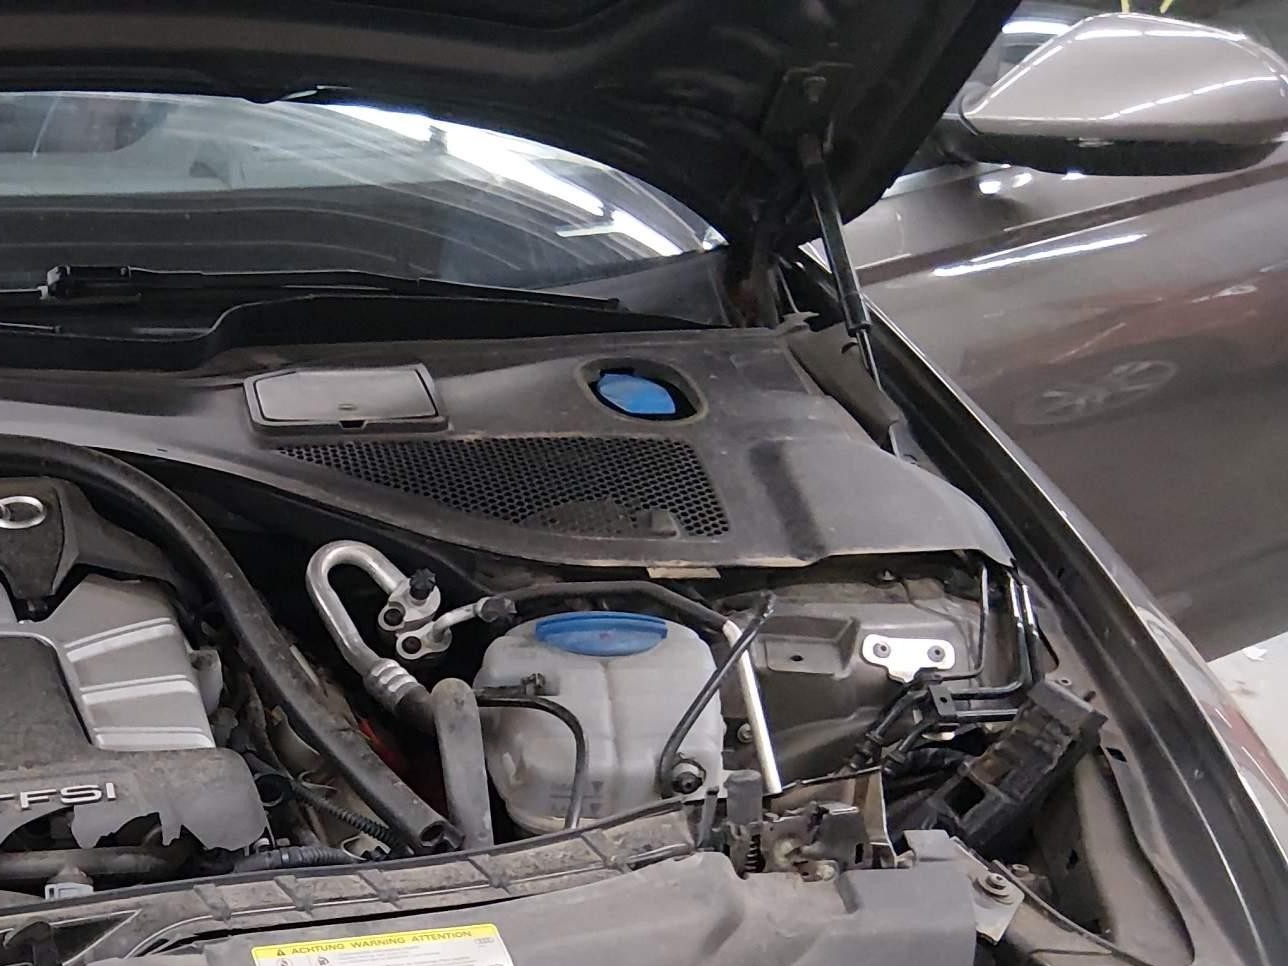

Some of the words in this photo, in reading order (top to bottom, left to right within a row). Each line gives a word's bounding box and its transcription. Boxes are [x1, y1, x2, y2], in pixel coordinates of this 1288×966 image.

[291, 943, 345, 955] ACHTUNG
[350, 937, 406, 949] WARNING
[411, 931, 472, 943] ATTENTION
